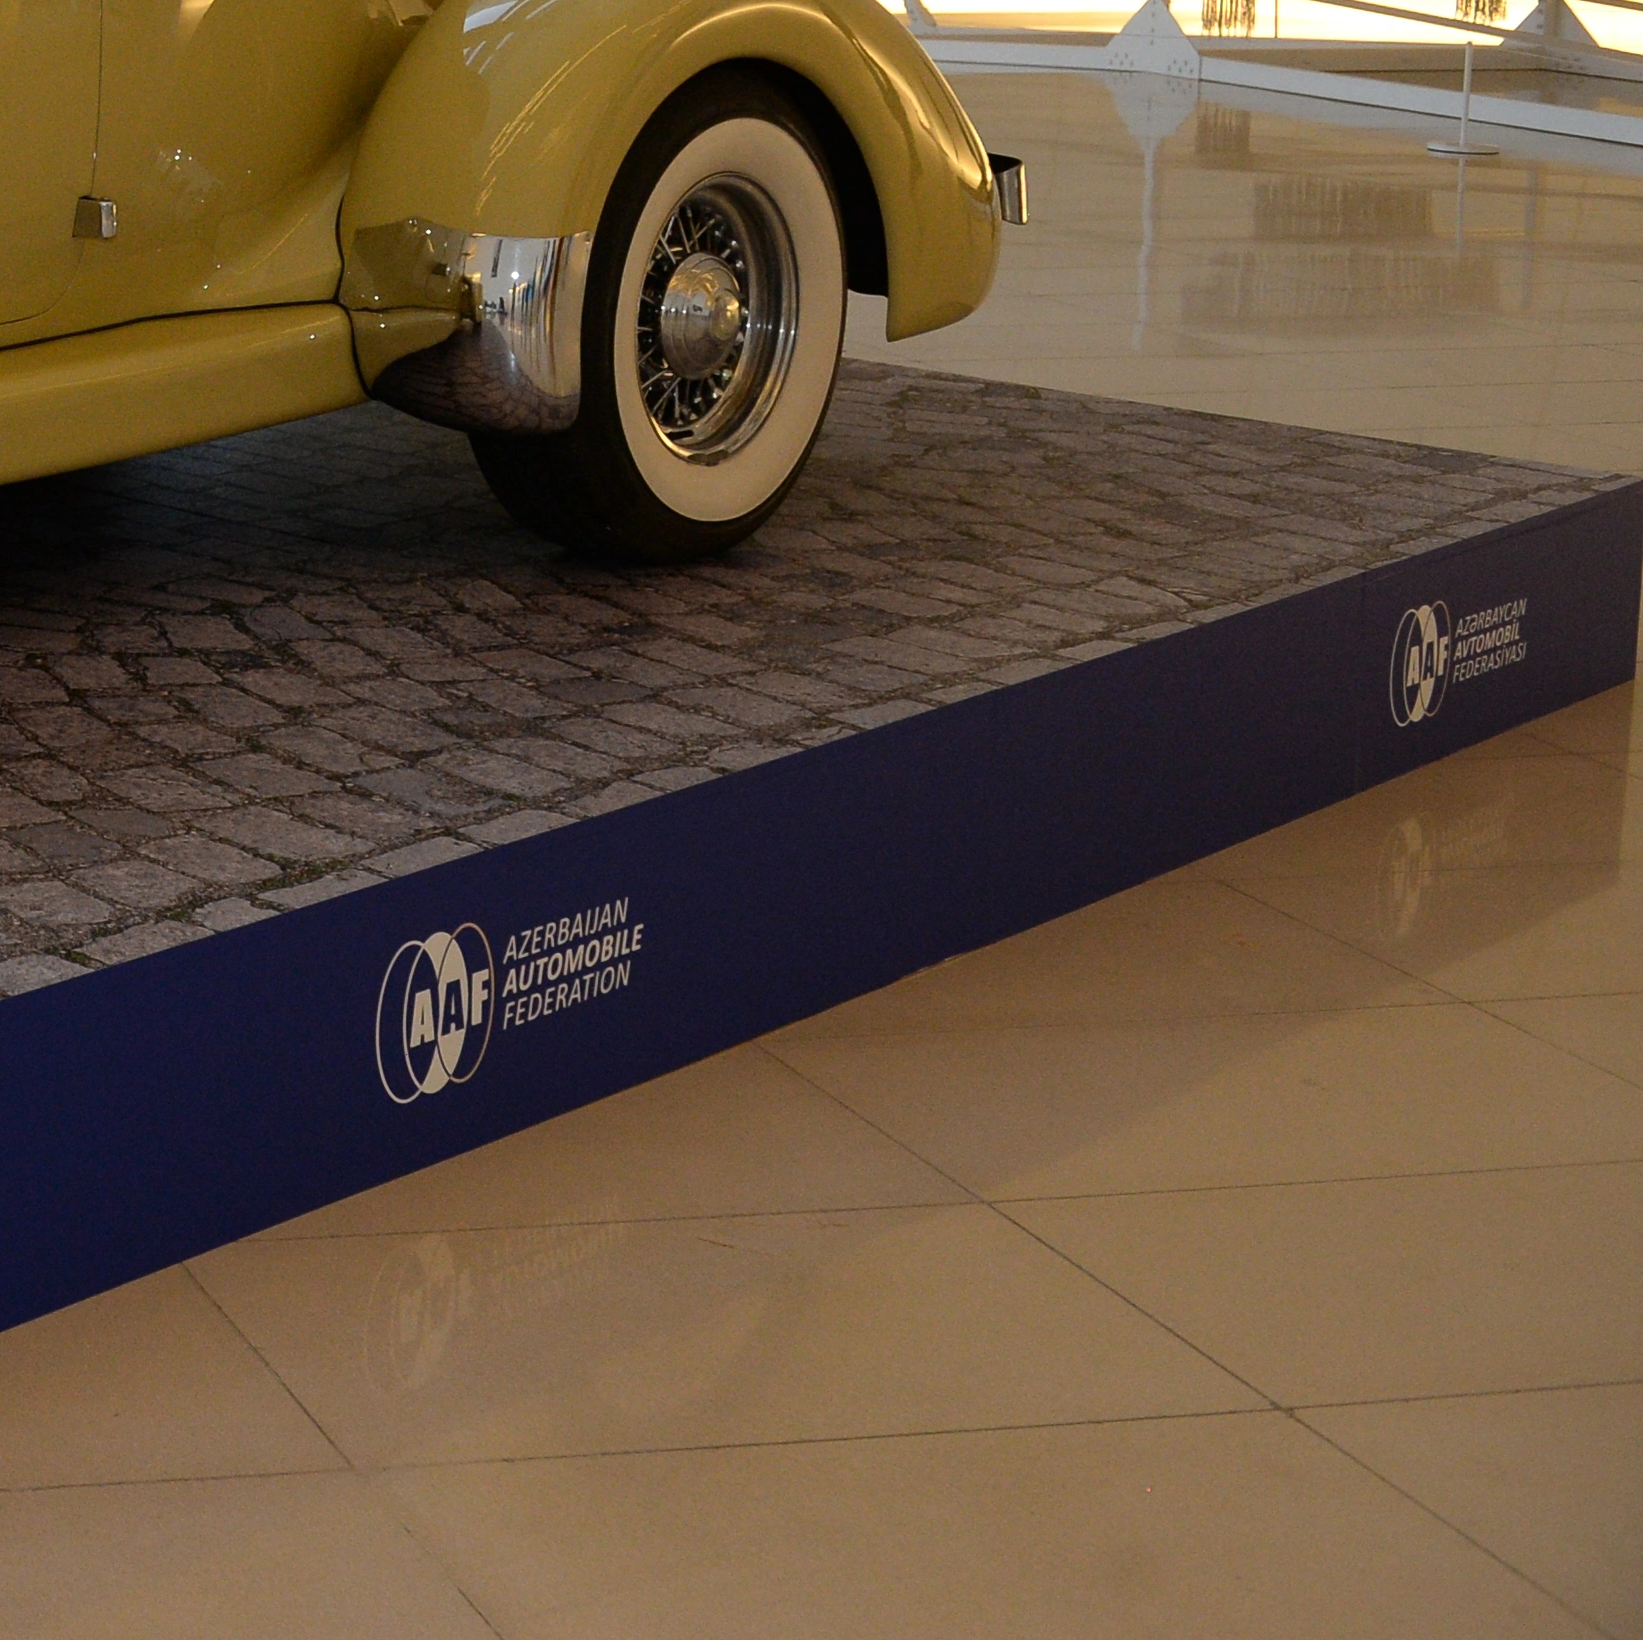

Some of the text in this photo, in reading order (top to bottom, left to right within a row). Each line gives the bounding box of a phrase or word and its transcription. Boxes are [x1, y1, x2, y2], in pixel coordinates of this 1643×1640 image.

[1405, 635, 1449, 688] AAF
[501, 923, 645, 998] AUTOMOBILE
[502, 896, 629, 965] AZERBAIJAN
[409, 968, 490, 1049] AAF
[502, 960, 631, 1031] FEDERATION
